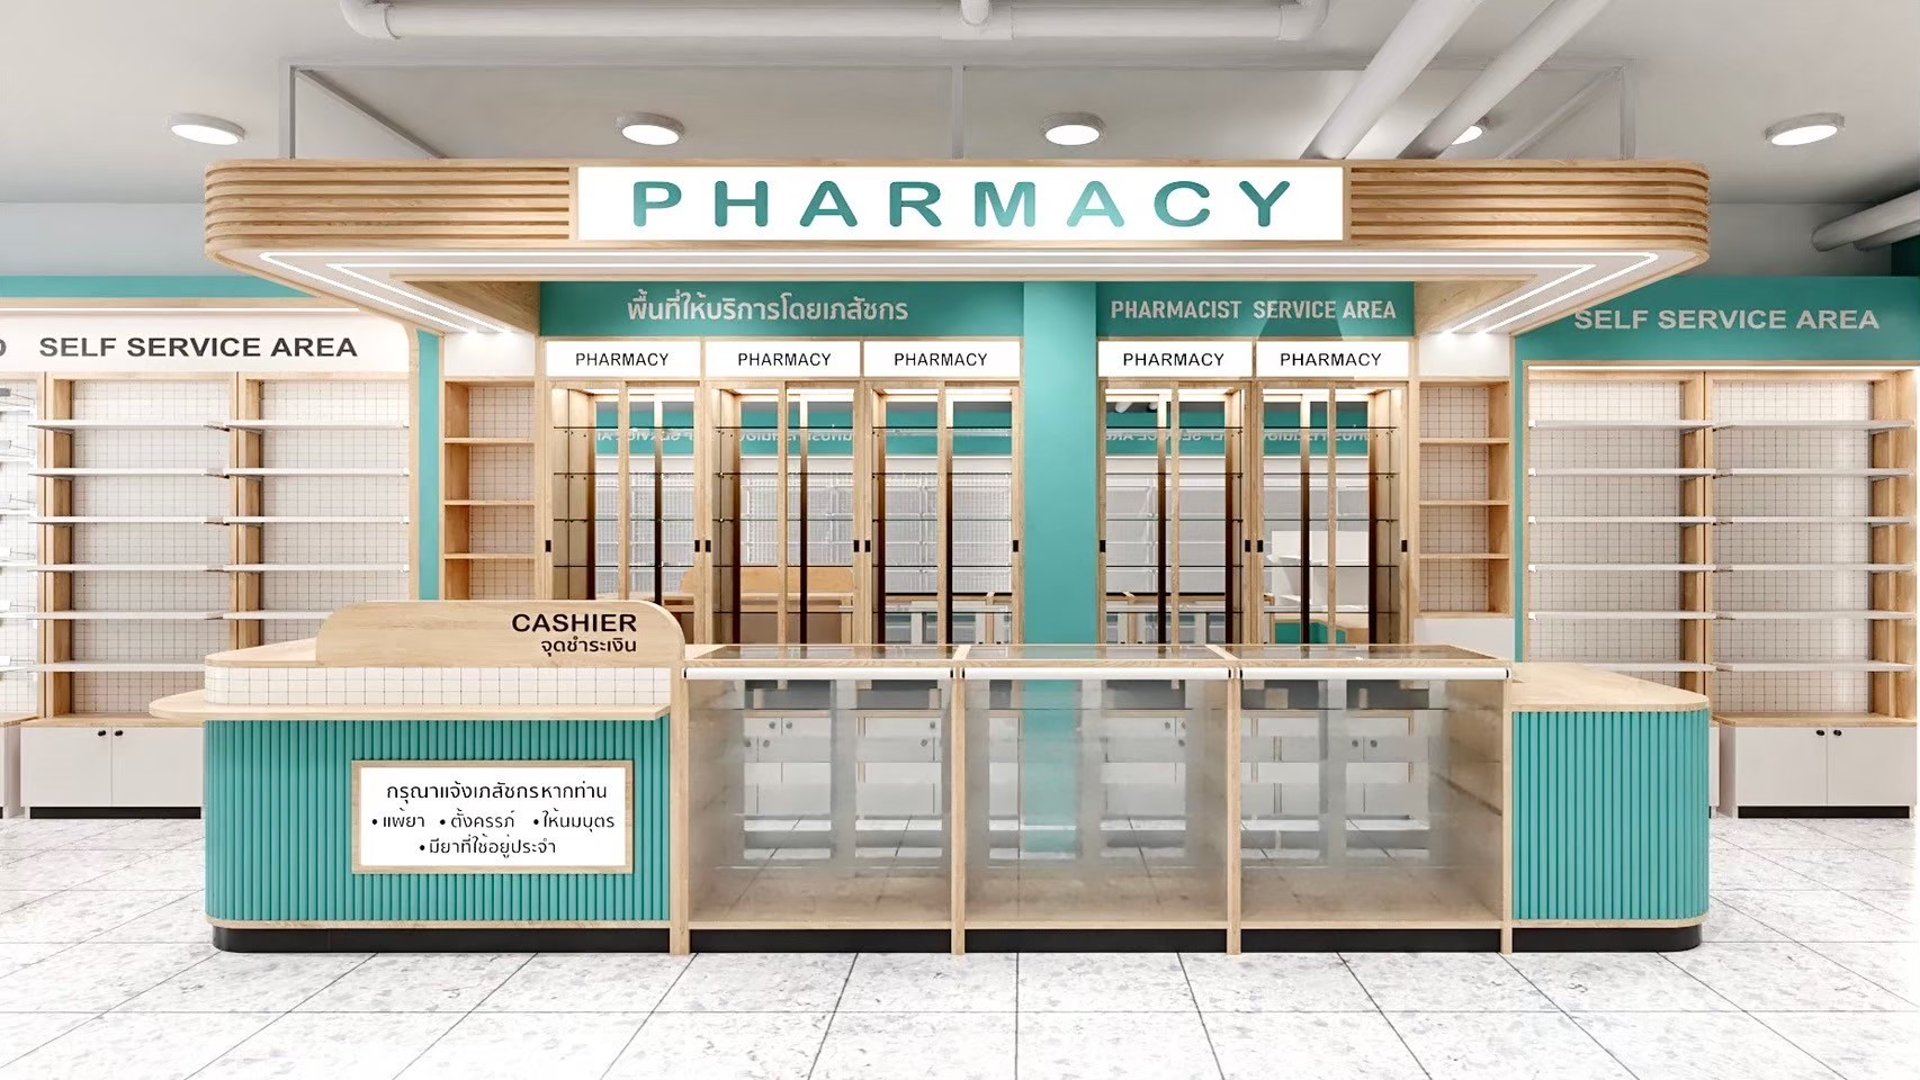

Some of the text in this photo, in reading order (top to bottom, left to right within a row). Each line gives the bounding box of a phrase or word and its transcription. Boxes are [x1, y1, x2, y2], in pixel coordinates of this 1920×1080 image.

[631, 180, 1293, 229] PHARMACY
[627, 288, 909, 321] พื้นที่ให้บริการโดยเภสัชกร
[1110, 300, 1397, 319] PHARMACIST SERVICE AREA
[1573, 309, 1880, 330] SELF SERVICE AREA
[39, 337, 358, 357] SELF SERVICE AREA
[575, 352, 670, 367] PHARMACY
[737, 352, 832, 367] PHARMACY
[893, 352, 988, 367] PHARMACY
[1122, 352, 1225, 367] PHARMACY
[1279, 352, 1382, 367] PHARMACY
[511, 613, 638, 633] CASHIER
[541, 635, 638, 658] จุดชำระเงิน
[382, 808, 616, 833] แพ้ยา ตั้งครรภ์ ให้นมบุตร
[428, 834, 556, 858] มียาที่ใช้อยู่ประจำ
